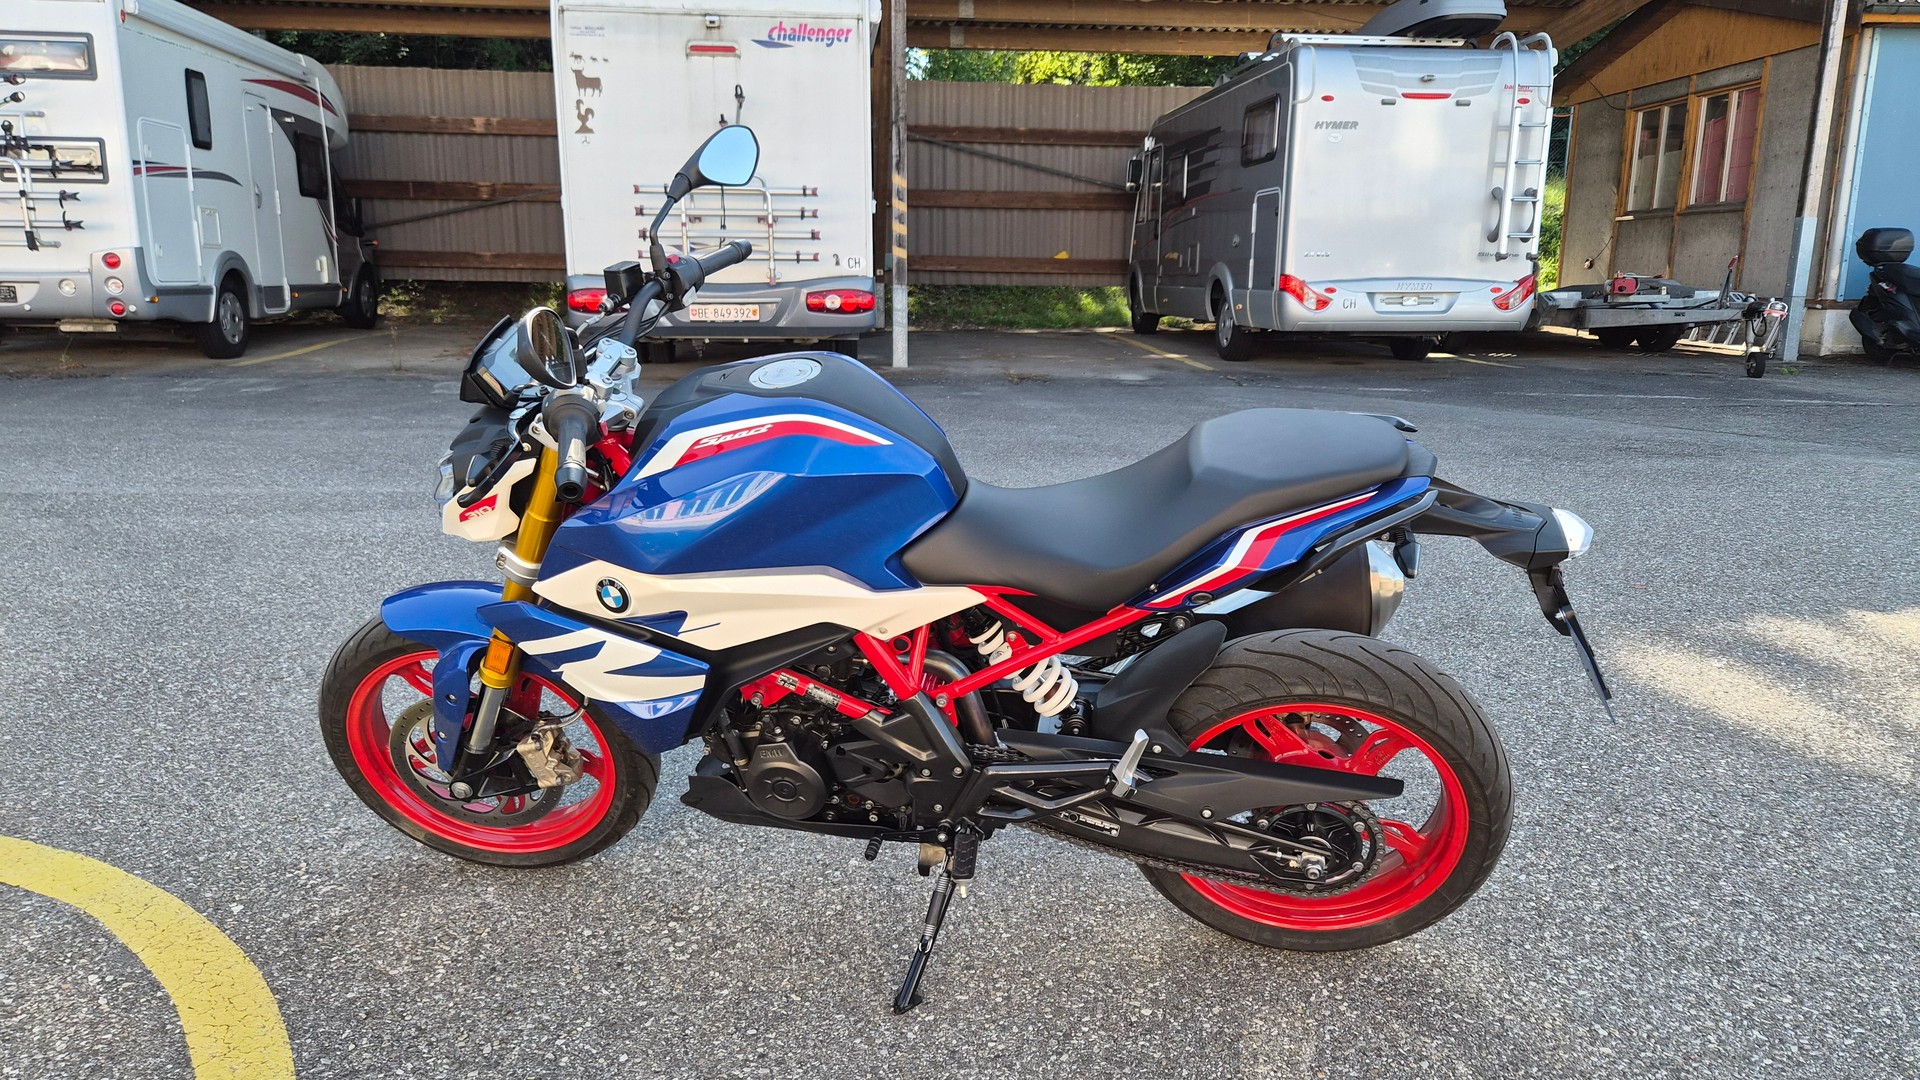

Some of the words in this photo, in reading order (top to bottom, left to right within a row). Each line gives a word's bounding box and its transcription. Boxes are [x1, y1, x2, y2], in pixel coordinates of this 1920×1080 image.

[767, 20, 853, 47] challenger
[1314, 120, 1359, 130] HYMER
[847, 257, 861, 269] CH
[1396, 282, 1433, 291] HYMER
[1342, 299, 1357, 310] CH
[597, 579, 622, 593] BMW
[760, 748, 784, 759] BMW
